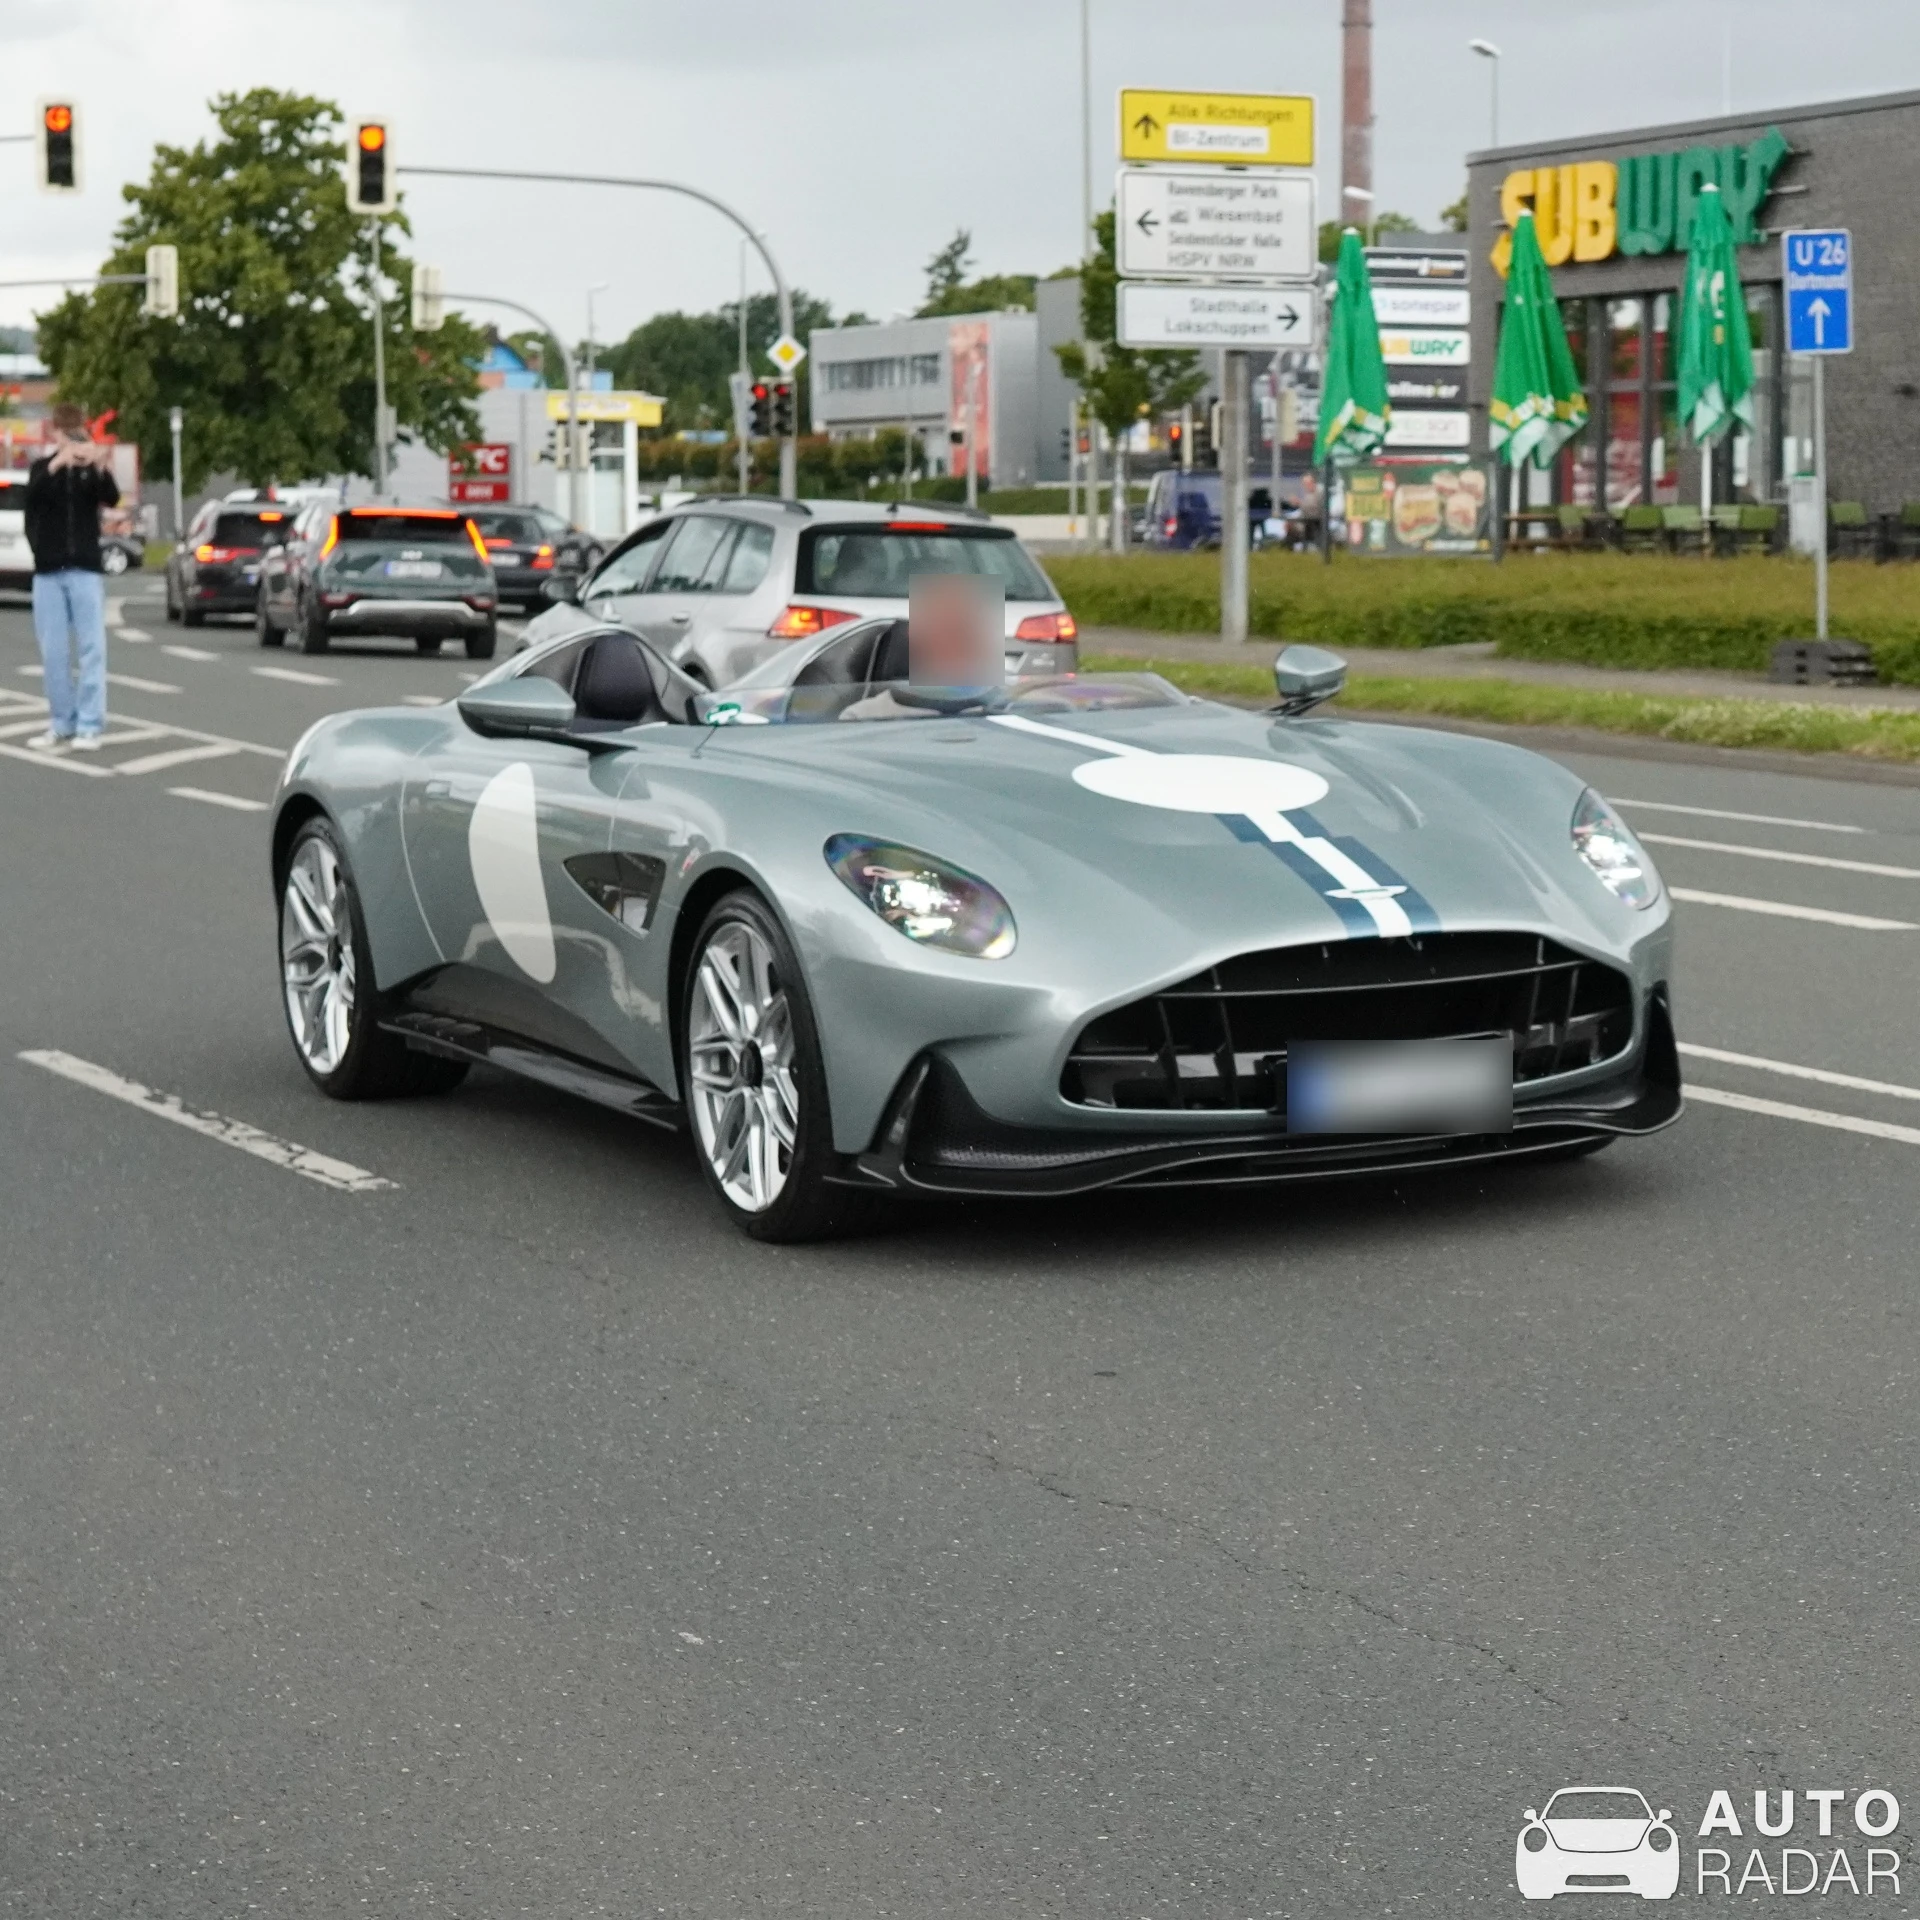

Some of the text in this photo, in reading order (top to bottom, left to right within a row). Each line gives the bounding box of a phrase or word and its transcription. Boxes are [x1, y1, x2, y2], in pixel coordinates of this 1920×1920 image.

[1168, 104, 1295, 124] Alle Richtungen
[1489, 125, 1792, 281] SUBWAY
[1198, 206, 1284, 224] Wiesenbad
[1217, 252, 1258, 268] NRW
[1795, 237, 1847, 267] U 26
[1189, 297, 1270, 314] Stadthalle
[1391, 300, 1462, 315] sonepar
[1165, 317, 1270, 336] Lokschuppen
[1381, 338, 1463, 356] UBWAY
